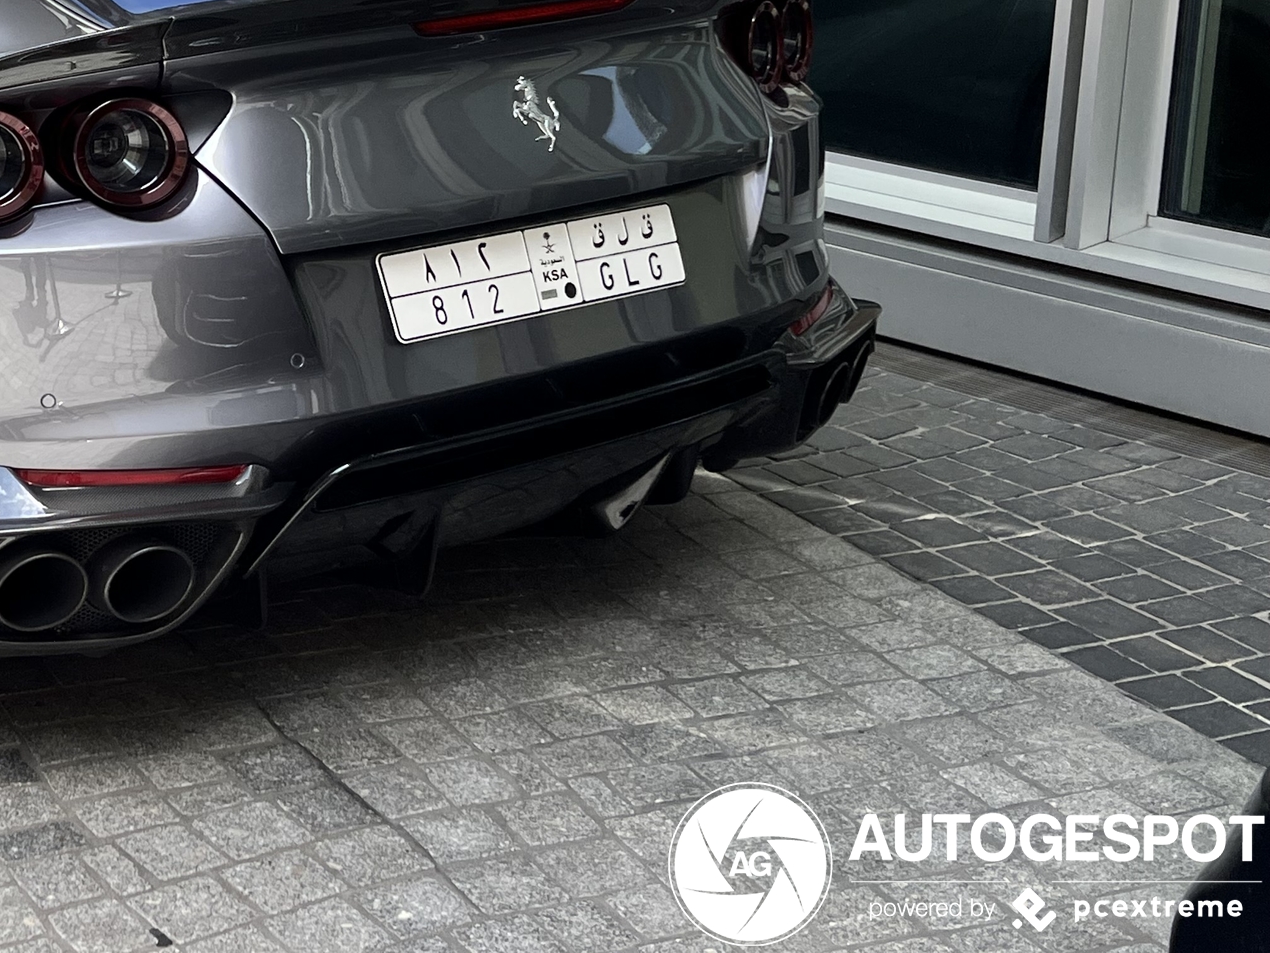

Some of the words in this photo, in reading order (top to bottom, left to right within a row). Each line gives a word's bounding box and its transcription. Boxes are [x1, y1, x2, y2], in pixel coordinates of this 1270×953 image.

[542, 268, 569, 283] KSA
[598, 252, 664, 291] GLG
[431, 284, 504, 326] 812
